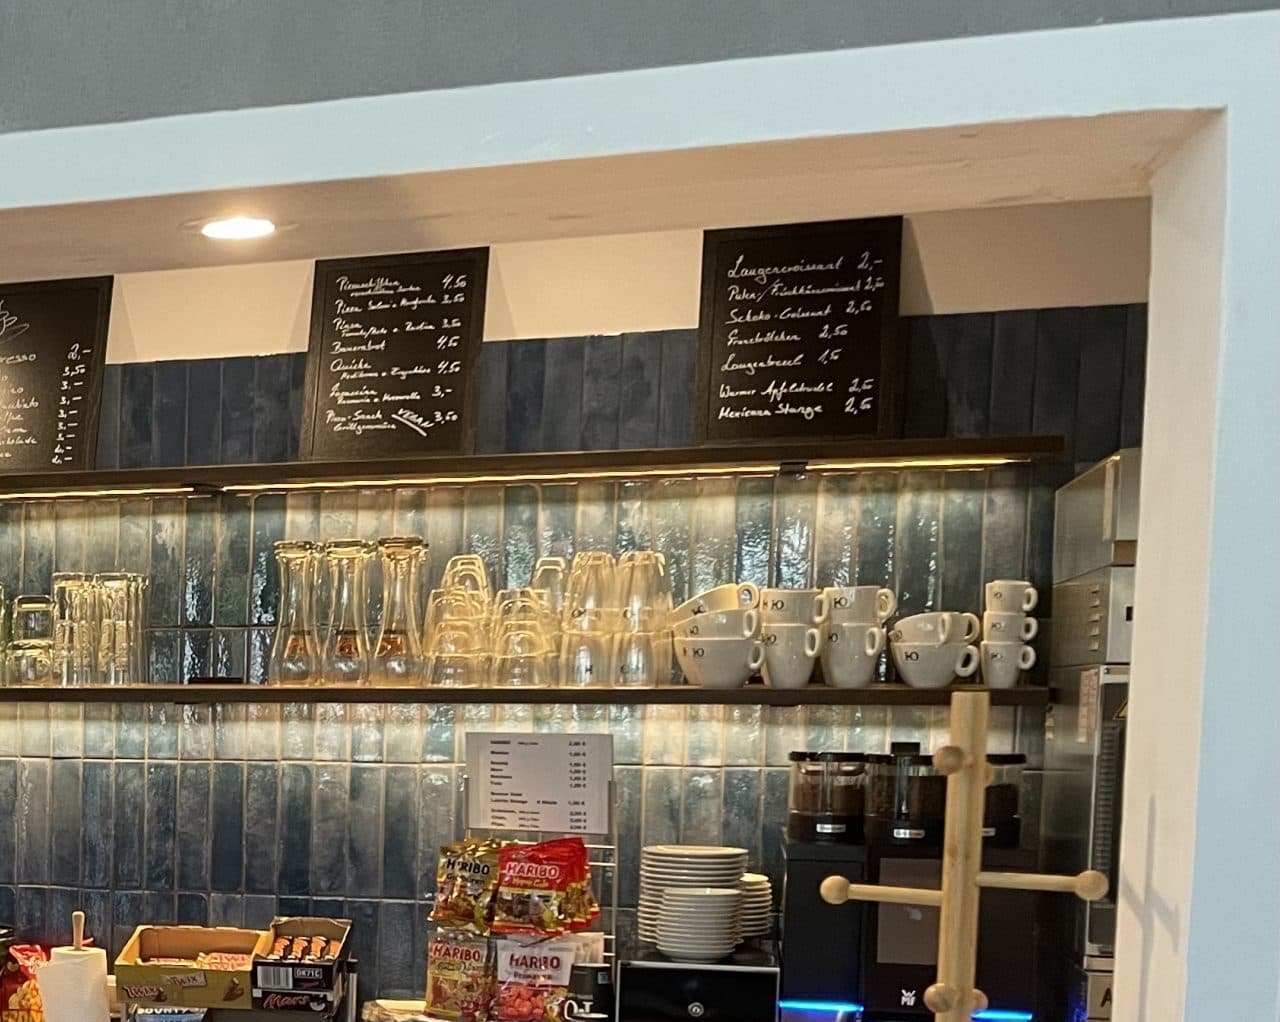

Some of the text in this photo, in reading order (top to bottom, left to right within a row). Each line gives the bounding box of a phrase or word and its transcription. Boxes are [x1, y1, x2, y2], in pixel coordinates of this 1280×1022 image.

[442, 273, 467, 289] 4,50
[818, 324, 848, 340] 2,50
[437, 360, 461, 375] 4,50
[431, 385, 453, 398] 3,-
[433, 411, 458, 425] 3,50
[505, 861, 560, 878] HARIBO
[433, 944, 480, 961] HARIBO
[509, 953, 560, 970] HARIBO
[264, 993, 309, 1009] Mars
